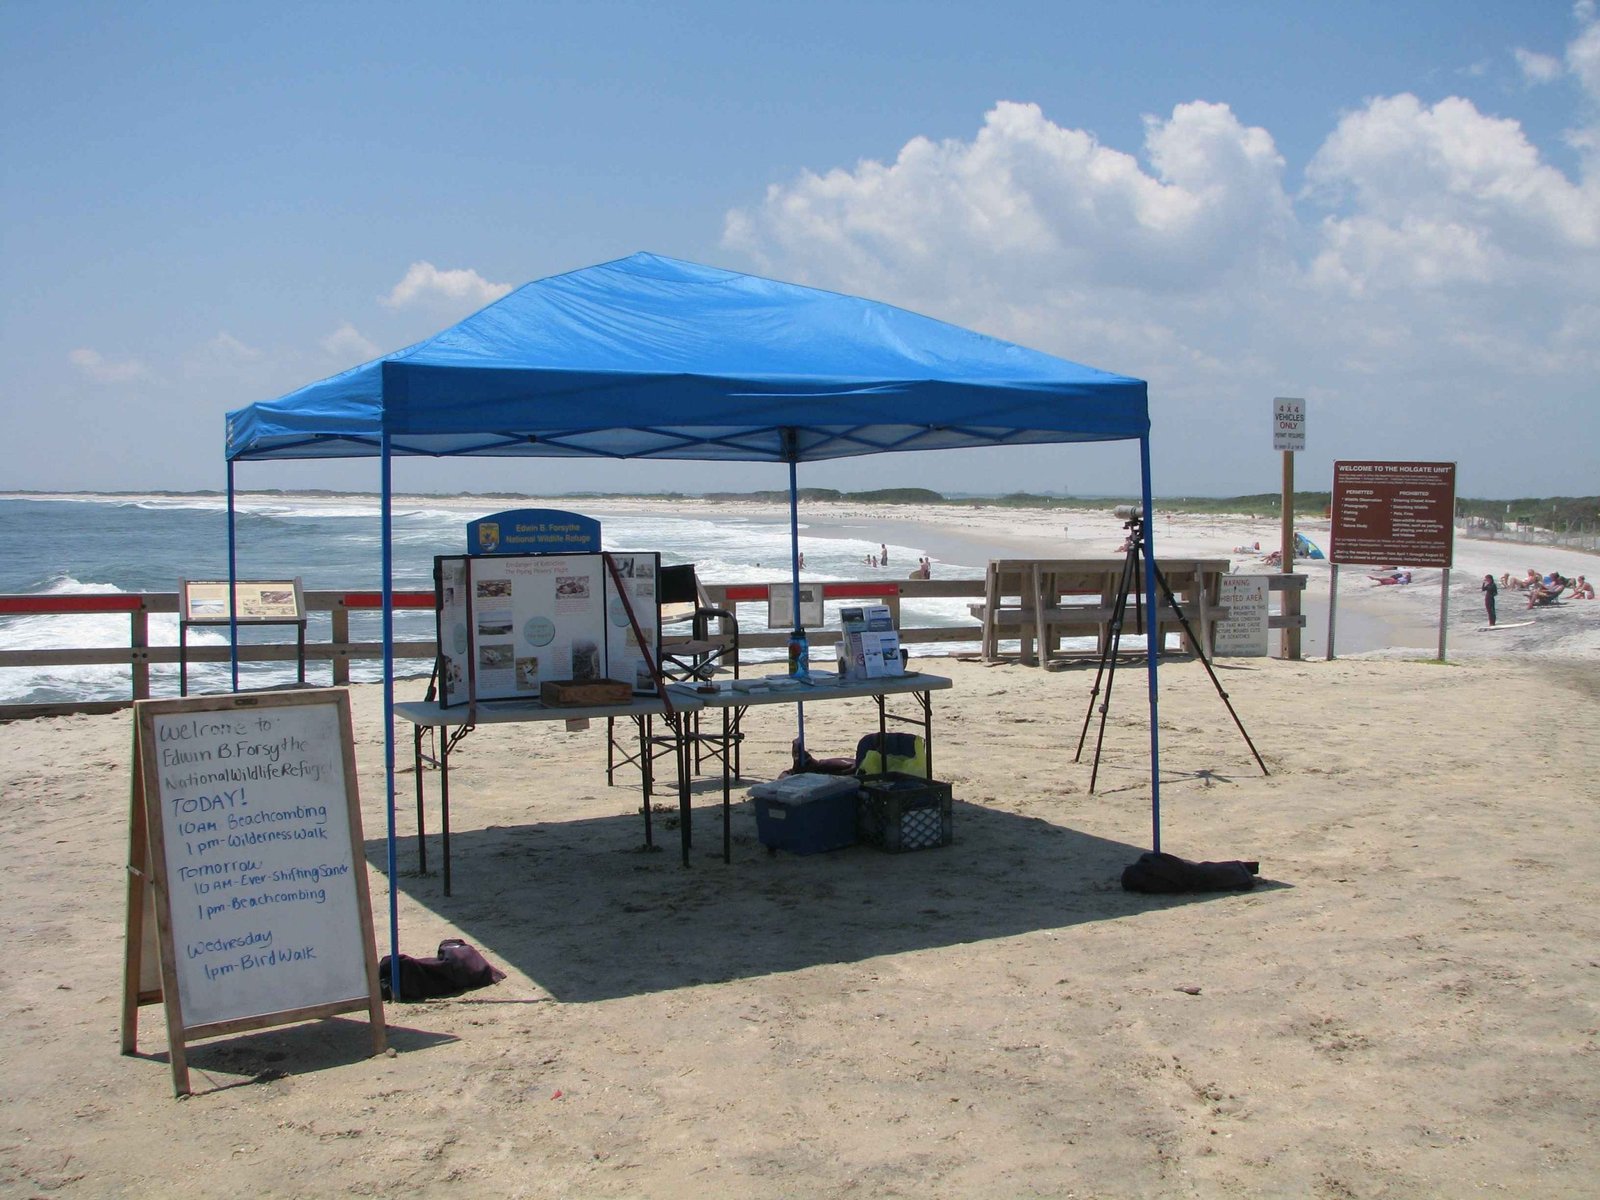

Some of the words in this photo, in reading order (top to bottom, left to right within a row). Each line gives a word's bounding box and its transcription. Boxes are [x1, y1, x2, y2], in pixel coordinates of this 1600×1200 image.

[1275, 413, 1305, 422] VEHICLES
[1280, 421, 1298, 430] ONLY
[516, 524, 538, 532] Edwin
[549, 524, 580, 533] Forsythe
[506, 535, 536, 543] National
[537, 534, 562, 543] Wildlife
[565, 534, 591, 544] Refuge
[162, 748, 212, 768] Edwin
[172, 788, 247, 817] TODAY!
[228, 805, 327, 831] Beachcombing
[293, 827, 328, 841] Walk
[177, 860, 262, 882] Tomorrow
[187, 930, 273, 959] Wednesday
[278, 946, 318, 962] Walk
